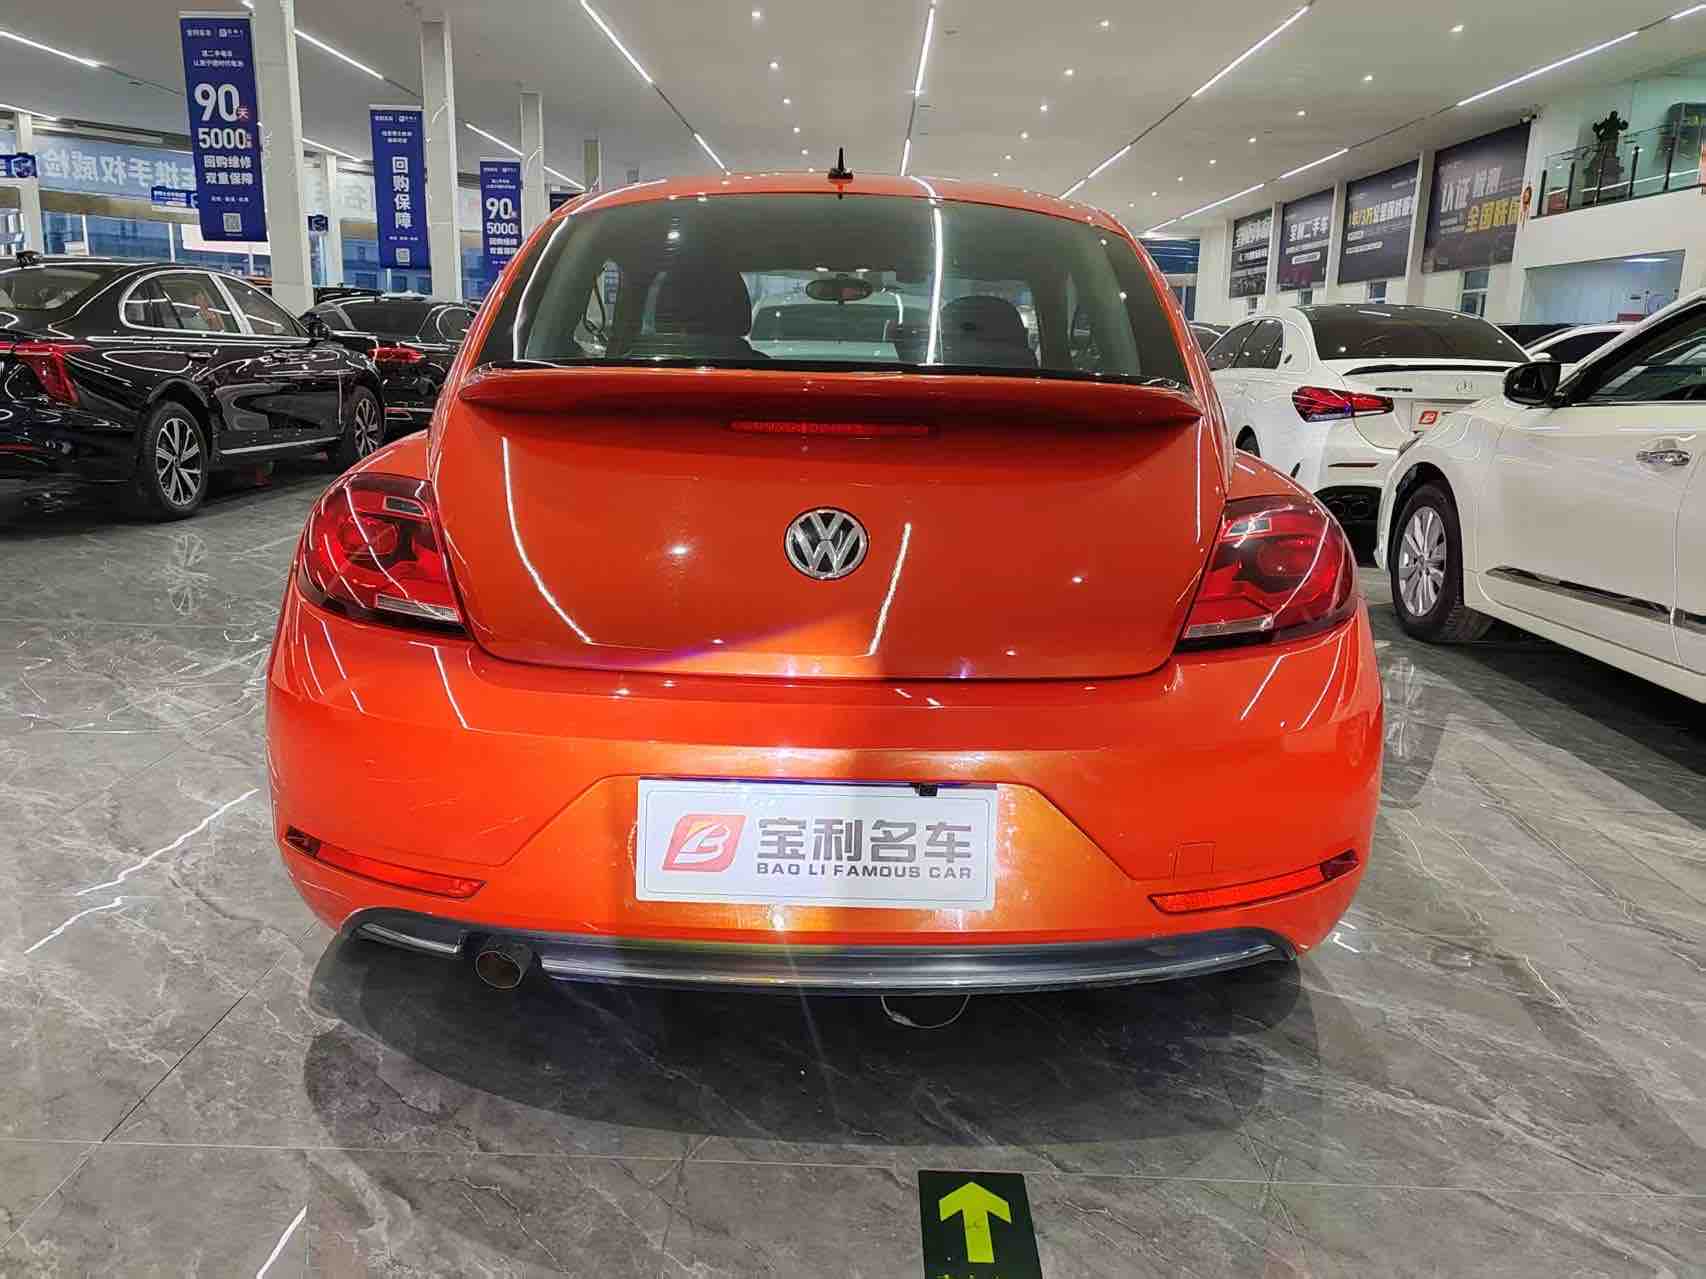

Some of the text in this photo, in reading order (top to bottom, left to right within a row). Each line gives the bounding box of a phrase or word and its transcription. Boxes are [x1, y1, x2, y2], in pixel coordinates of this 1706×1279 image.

[392, 156, 414, 230] 回购保障
[485, 197, 517, 220] 90
[757, 817, 972, 864] 宝利名车
[757, 862, 972, 879] BAO LI FAMOUS CAR
